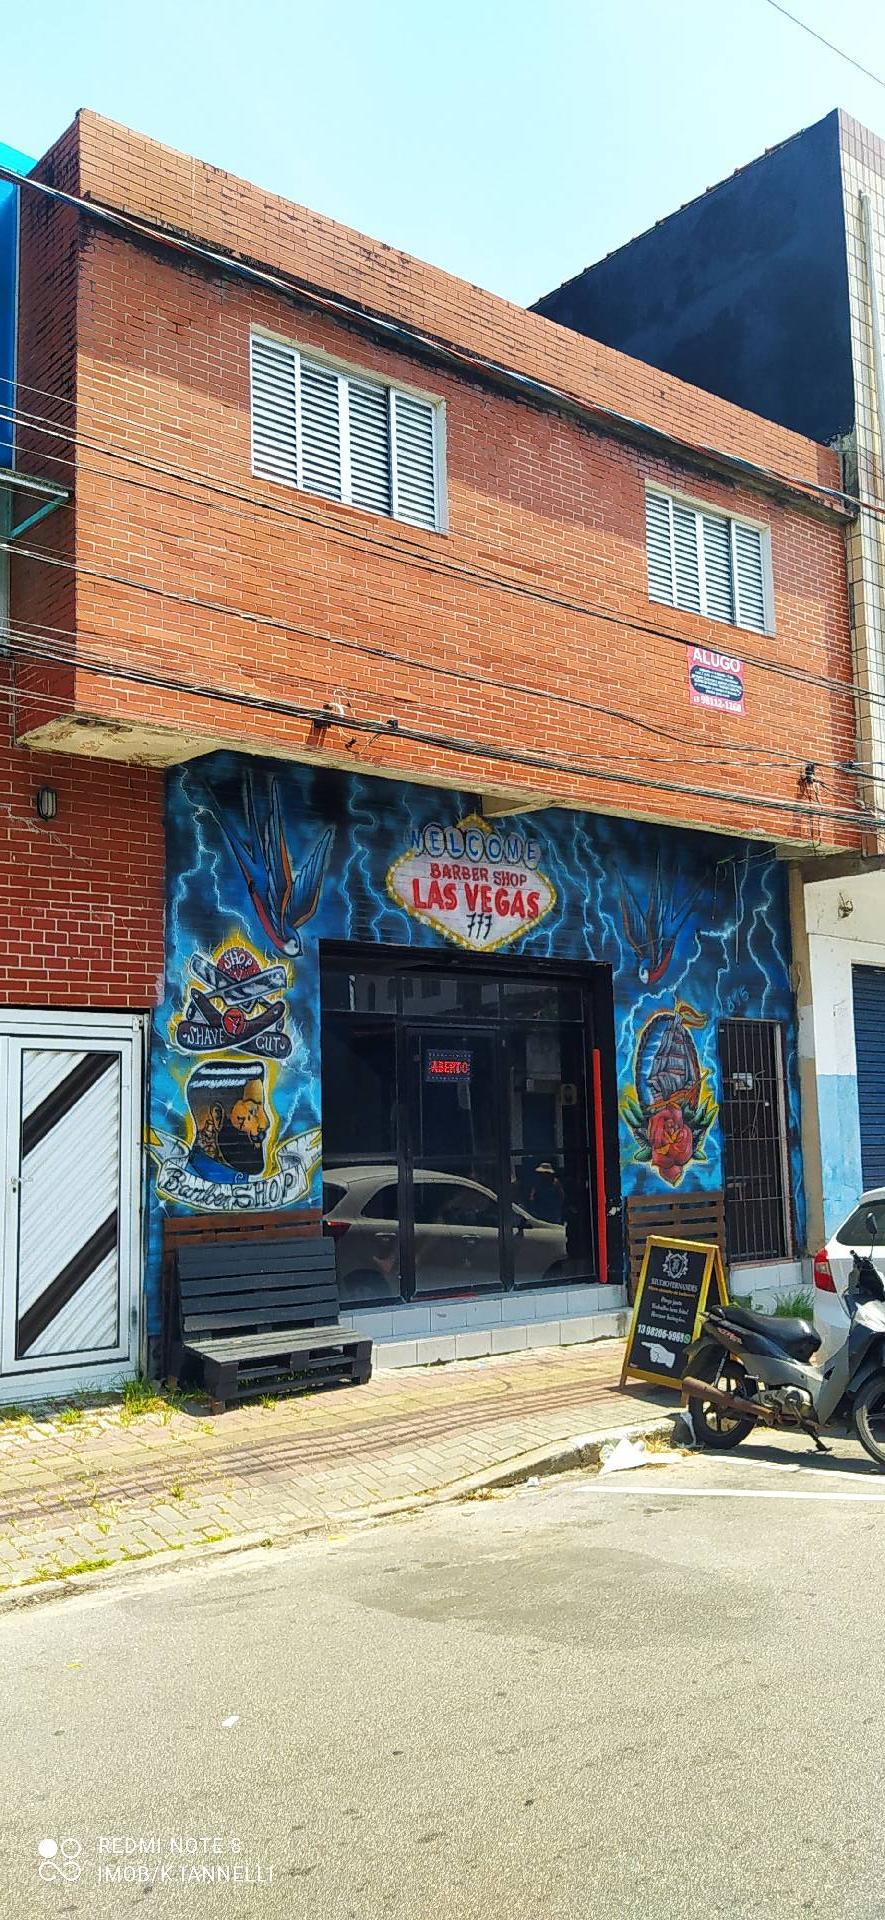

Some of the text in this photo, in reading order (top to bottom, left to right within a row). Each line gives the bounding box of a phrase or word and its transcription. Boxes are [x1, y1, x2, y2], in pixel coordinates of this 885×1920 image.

[693, 648, 741, 672] ALUGO
[430, 863, 528, 887] BARBER SHOP
[412, 879, 541, 919] LAS VEGAS
[466, 912, 493, 941] 777
[223, 950, 253, 969] SHOP
[187, 1026, 225, 1045] SHAVE
[431, 1061, 468, 1074] ABERTO
[637, 1324, 646, 1334] 13
